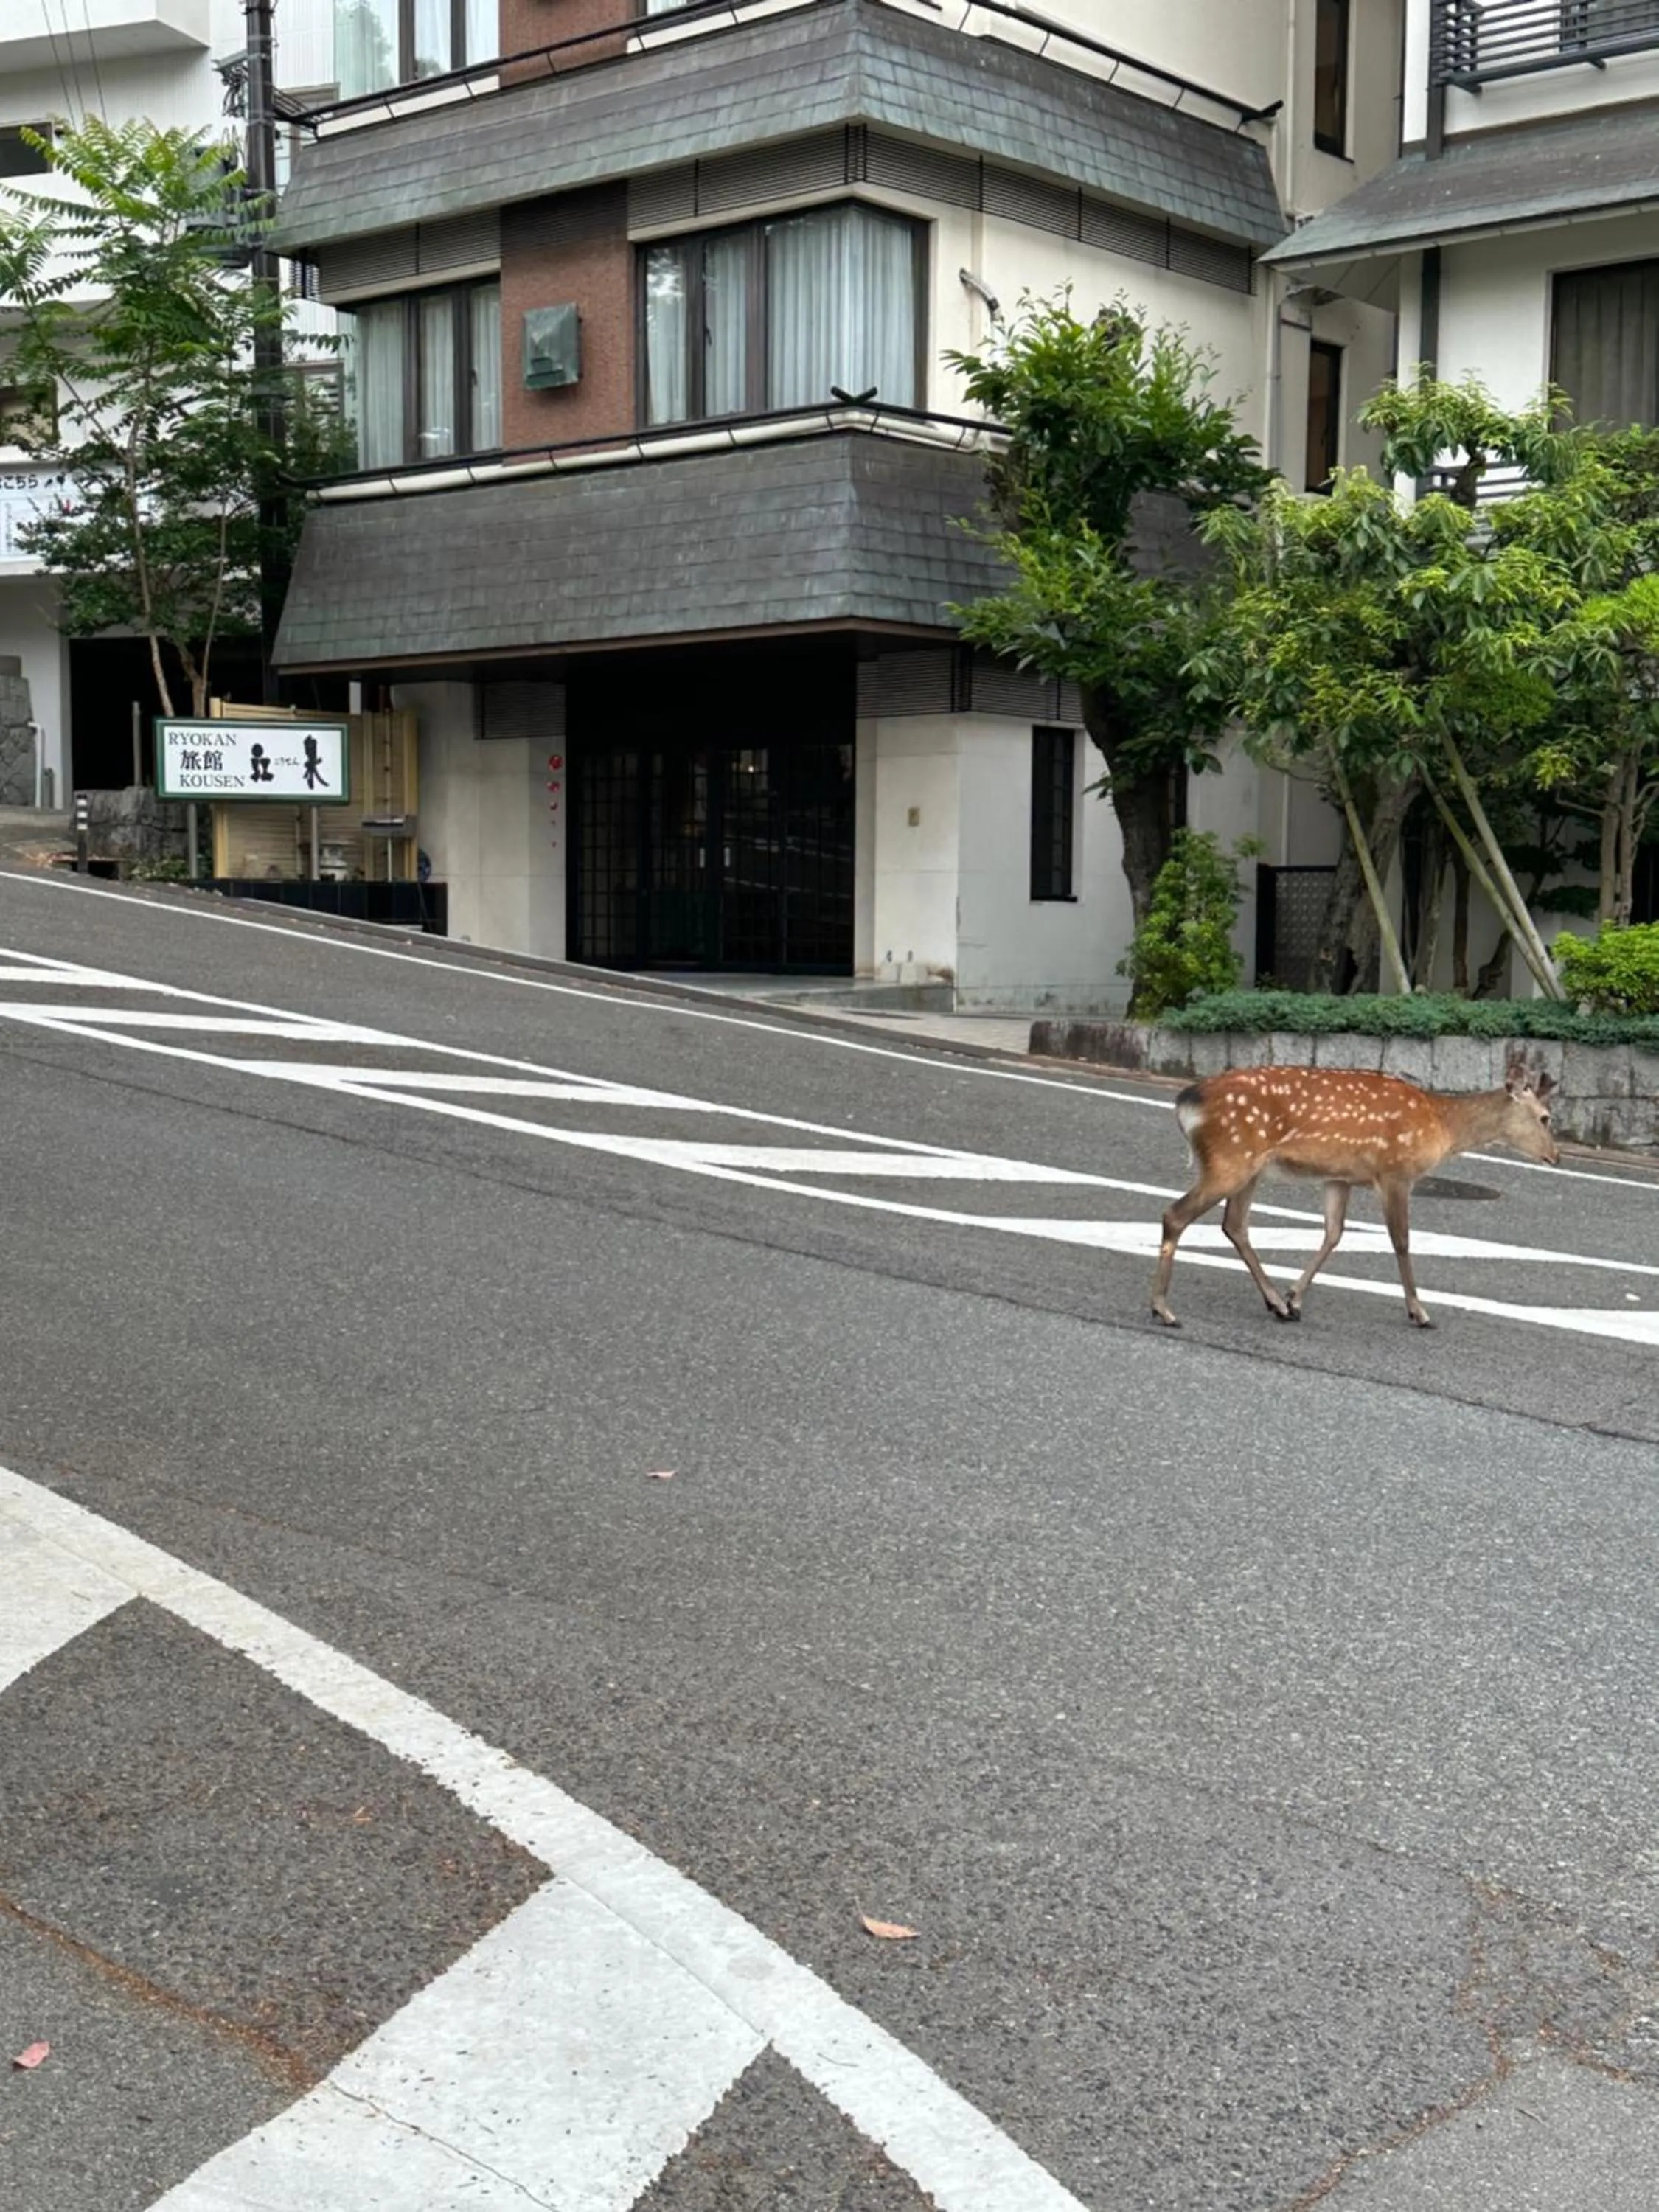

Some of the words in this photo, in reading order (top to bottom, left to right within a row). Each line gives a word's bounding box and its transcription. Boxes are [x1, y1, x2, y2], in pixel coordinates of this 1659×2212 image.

[0, 474, 39, 490] こちら
[168, 732, 237, 746] RYOKAN
[180, 749, 223, 771] 旅館
[179, 774, 246, 788] KOUSEN
